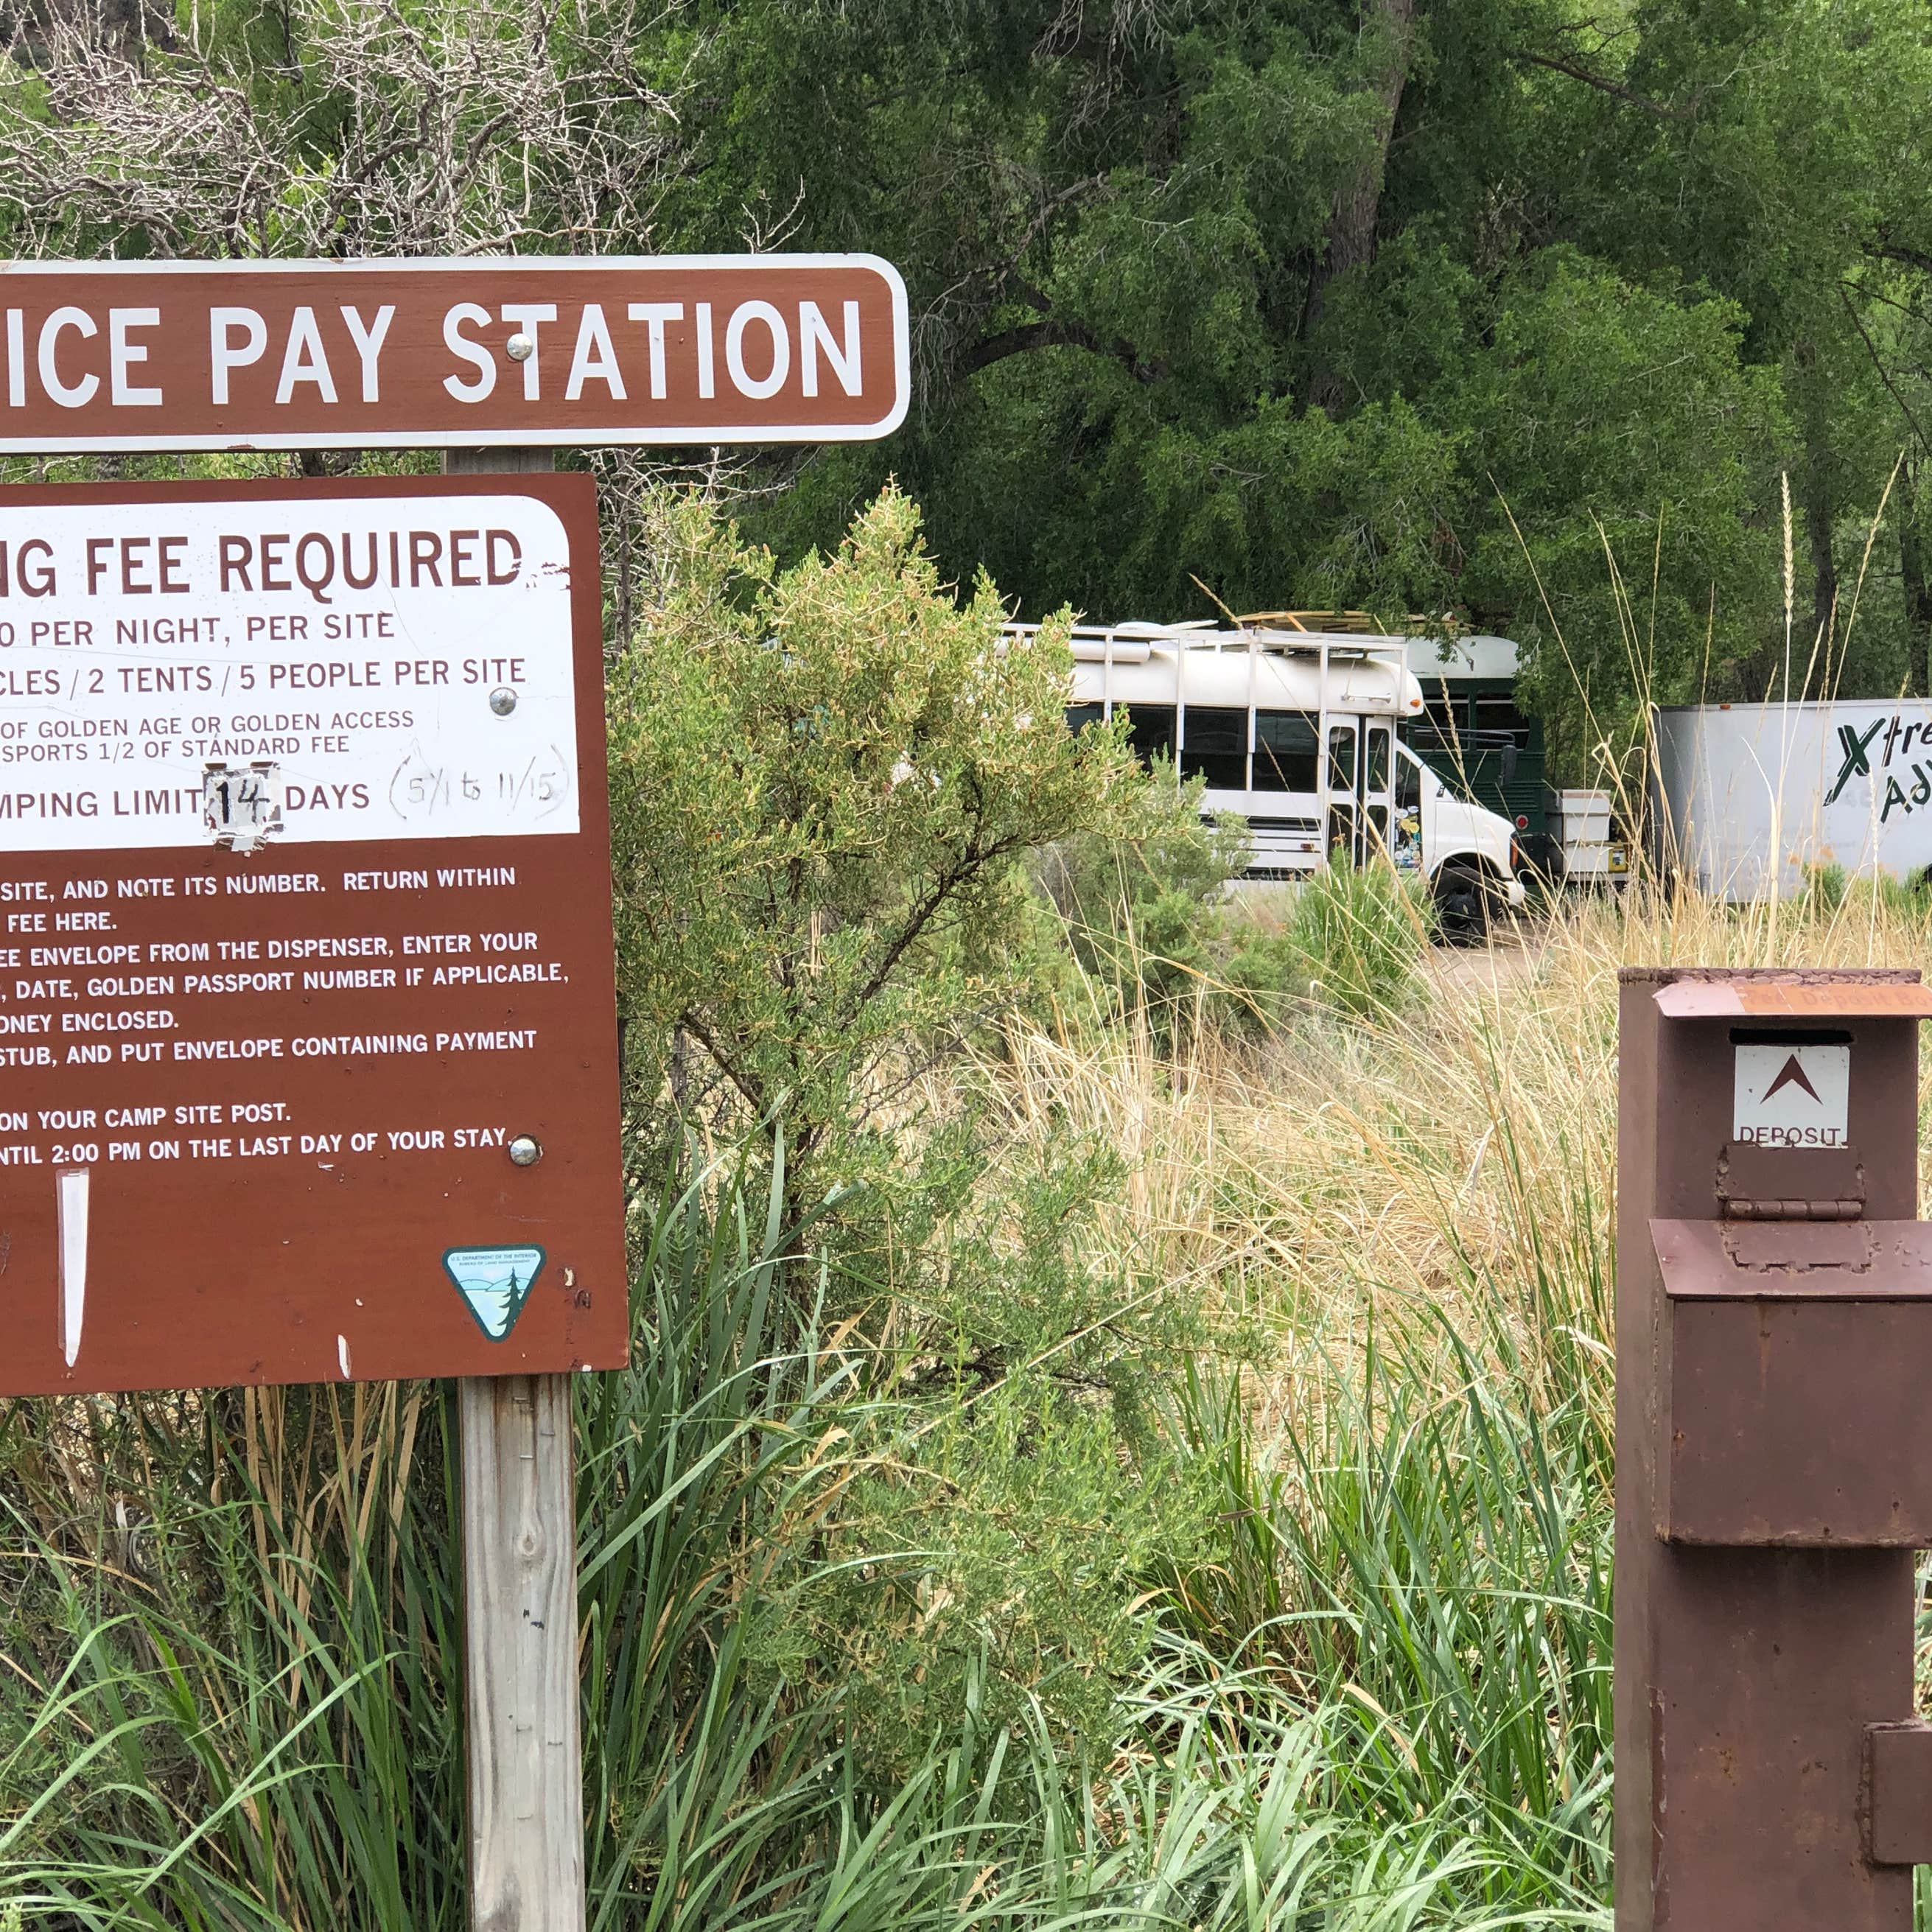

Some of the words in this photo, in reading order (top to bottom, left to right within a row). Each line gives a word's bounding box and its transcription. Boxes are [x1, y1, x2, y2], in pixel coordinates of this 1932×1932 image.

[7, 307, 162, 407] ICE
[211, 306, 396, 404] PAY
[443, 301, 862, 402] STATION
[86, 536, 189, 595] FEE
[219, 530, 522, 604] REQUIRED
[32, 621, 92, 645] PER
[116, 617, 229, 647] NIGHT,
[248, 616, 307, 640] PER
[324, 611, 394, 639] SITE
[118, 666, 211, 692] TENTS
[270, 662, 380, 688] PEOPLE
[395, 660, 449, 685] PER
[463, 659, 525, 684] SITE
[1, 722, 27, 739] OF
[39, 719, 127, 738] GOLDEN
[139, 718, 181, 735] AGE
[192, 717, 220, 733] OR
[231, 713, 319, 732] GOLDEN
[332, 711, 413, 729] ACCESS
[2, 743, 87, 762] SPORTS
[99, 742, 134, 763] 1/2
[145, 741, 171, 757] OF
[182, 738, 300, 757] STANDARD
[312, 736, 349, 752] FEE
[461, 771, 480, 799] to
[114, 789, 203, 816] LIMIT
[217, 780, 270, 824] 14
[286, 784, 369, 810] DAYS
[1, 882, 54, 903] SITE,
[63, 881, 108, 899] AND
[118, 878, 175, 897] NOTE
[186, 877, 217, 895] ITS
[226, 874, 325, 894] NUMBER.
[344, 871, 427, 890] RETURN
[437, 867, 514, 886] WITHIN
[8, 914, 46, 932] FEE
[56, 912, 116, 931] HERE.
[31, 945, 140, 966] ENVELOPE
[150, 943, 209, 962] FROM
[217, 942, 259, 959] THE
[268, 937, 393, 958] DISPENSER,
[403, 935, 471, 953] ENTER
[480, 933, 537, 951] YOUR
[16, 980, 77, 1000] DATE,
[88, 976, 173, 996] GOLDEN
[185, 973, 294, 993] PASSPORT
[304, 970, 396, 989] NUMBER
[407, 968, 424, 986] IF
[433, 964, 568, 984] APPLICABLE,
[63, 1011, 178, 1032] ENCLOSED.
[67, 1045, 111, 1063] AND
[122, 1043, 164, 1062] PUT
[174, 1039, 283, 1060] ENVELOPE
[292, 1035, 427, 1056] CONTAINING
[436, 1031, 536, 1051] PAYMENT
[38, 1110, 96, 1129] YOUR
[105, 1107, 166, 1127] CAMP
[175, 1105, 222, 1124] SITE
[232, 1103, 290, 1122] POST.
[52, 1144, 98, 1163] 2:00
[109, 1142, 140, 1161] PM
[150, 1141, 179, 1159] ON
[189, 1139, 231, 1158] THE
[240, 1136, 291, 1155] LAST
[301, 1135, 342, 1153] DAY
[351, 1133, 377, 1151] OF
[388, 1131, 444, 1149] YOUR
[1740, 1127, 1841, 1146] DEPOSIT
